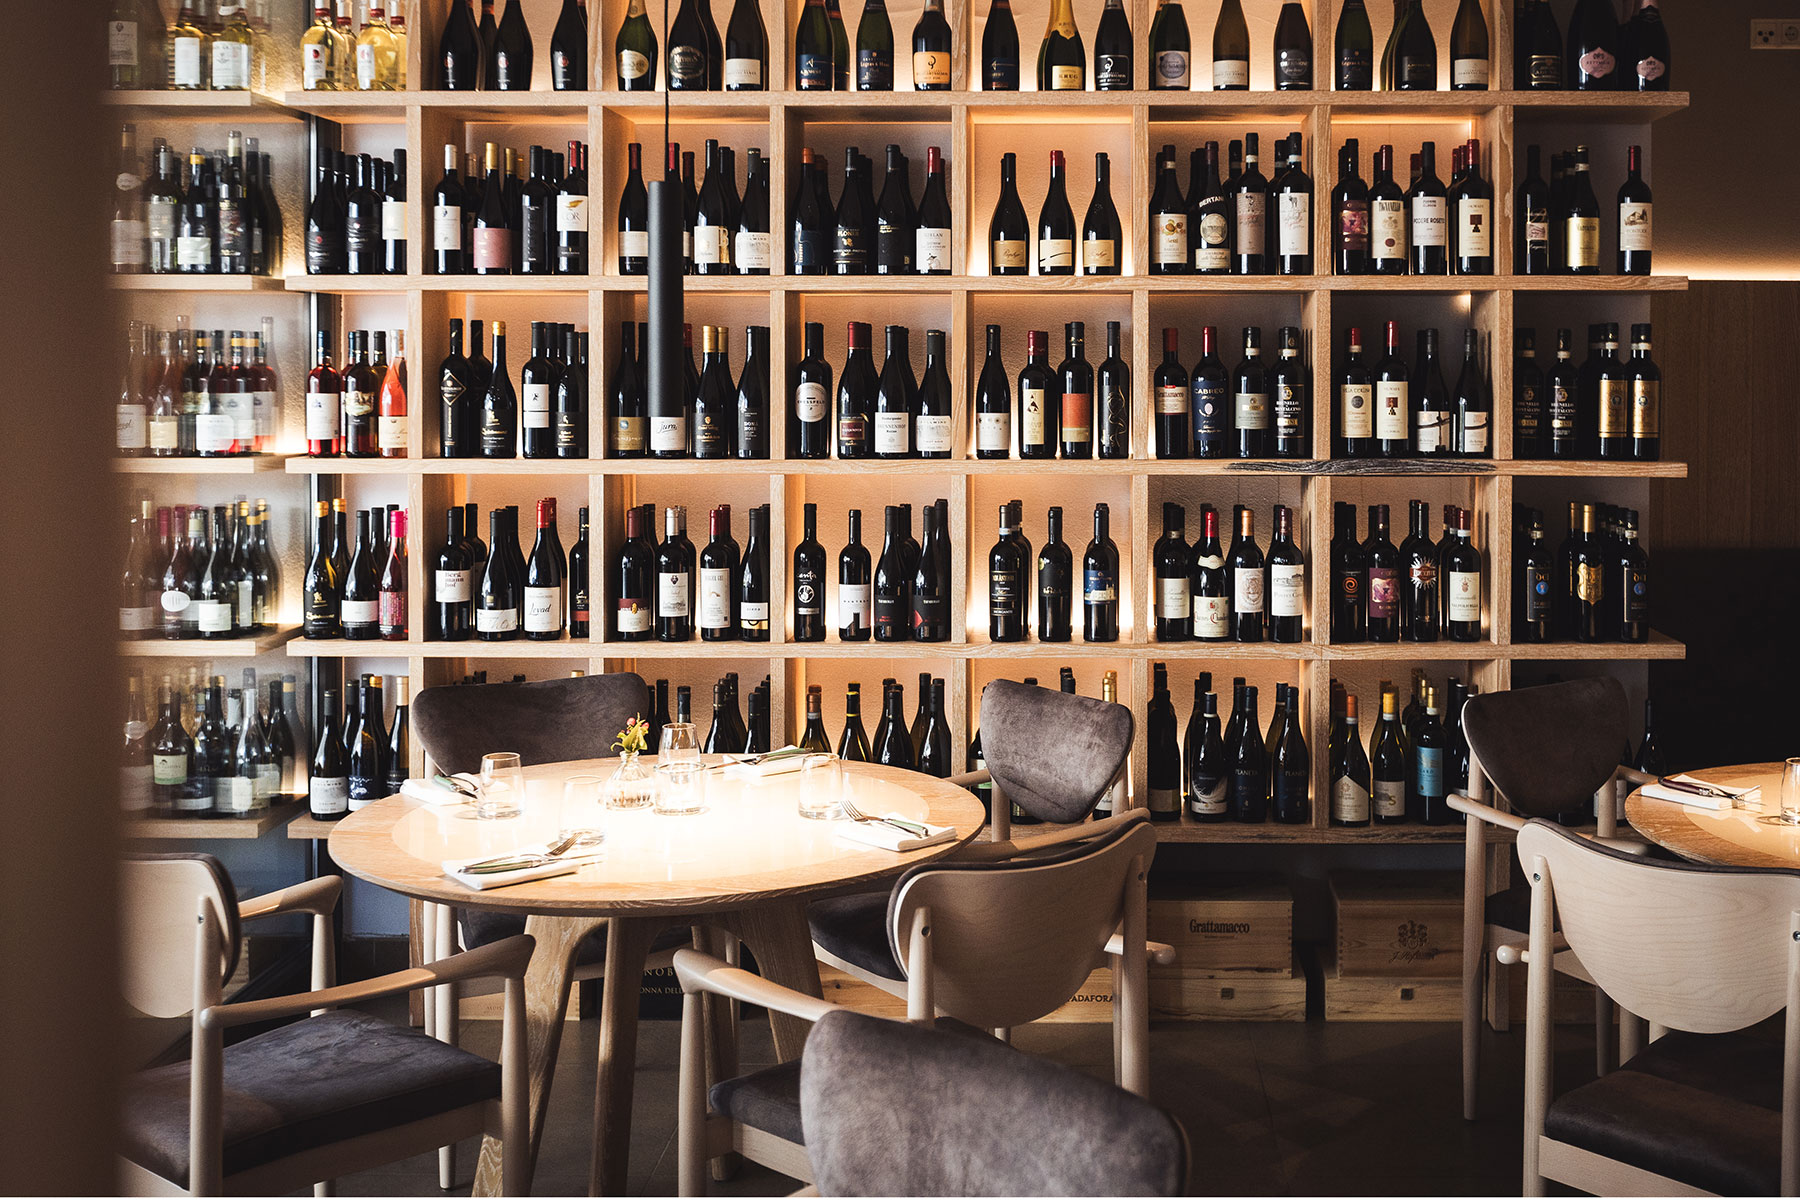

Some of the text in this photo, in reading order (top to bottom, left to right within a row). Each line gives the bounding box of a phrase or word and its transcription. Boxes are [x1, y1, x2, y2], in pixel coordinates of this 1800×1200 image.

[1193, 387, 1225, 395] CABREO
[1189, 918, 1251, 935] Grattamacco
[1067, 993, 1114, 1003] ADAFORA
